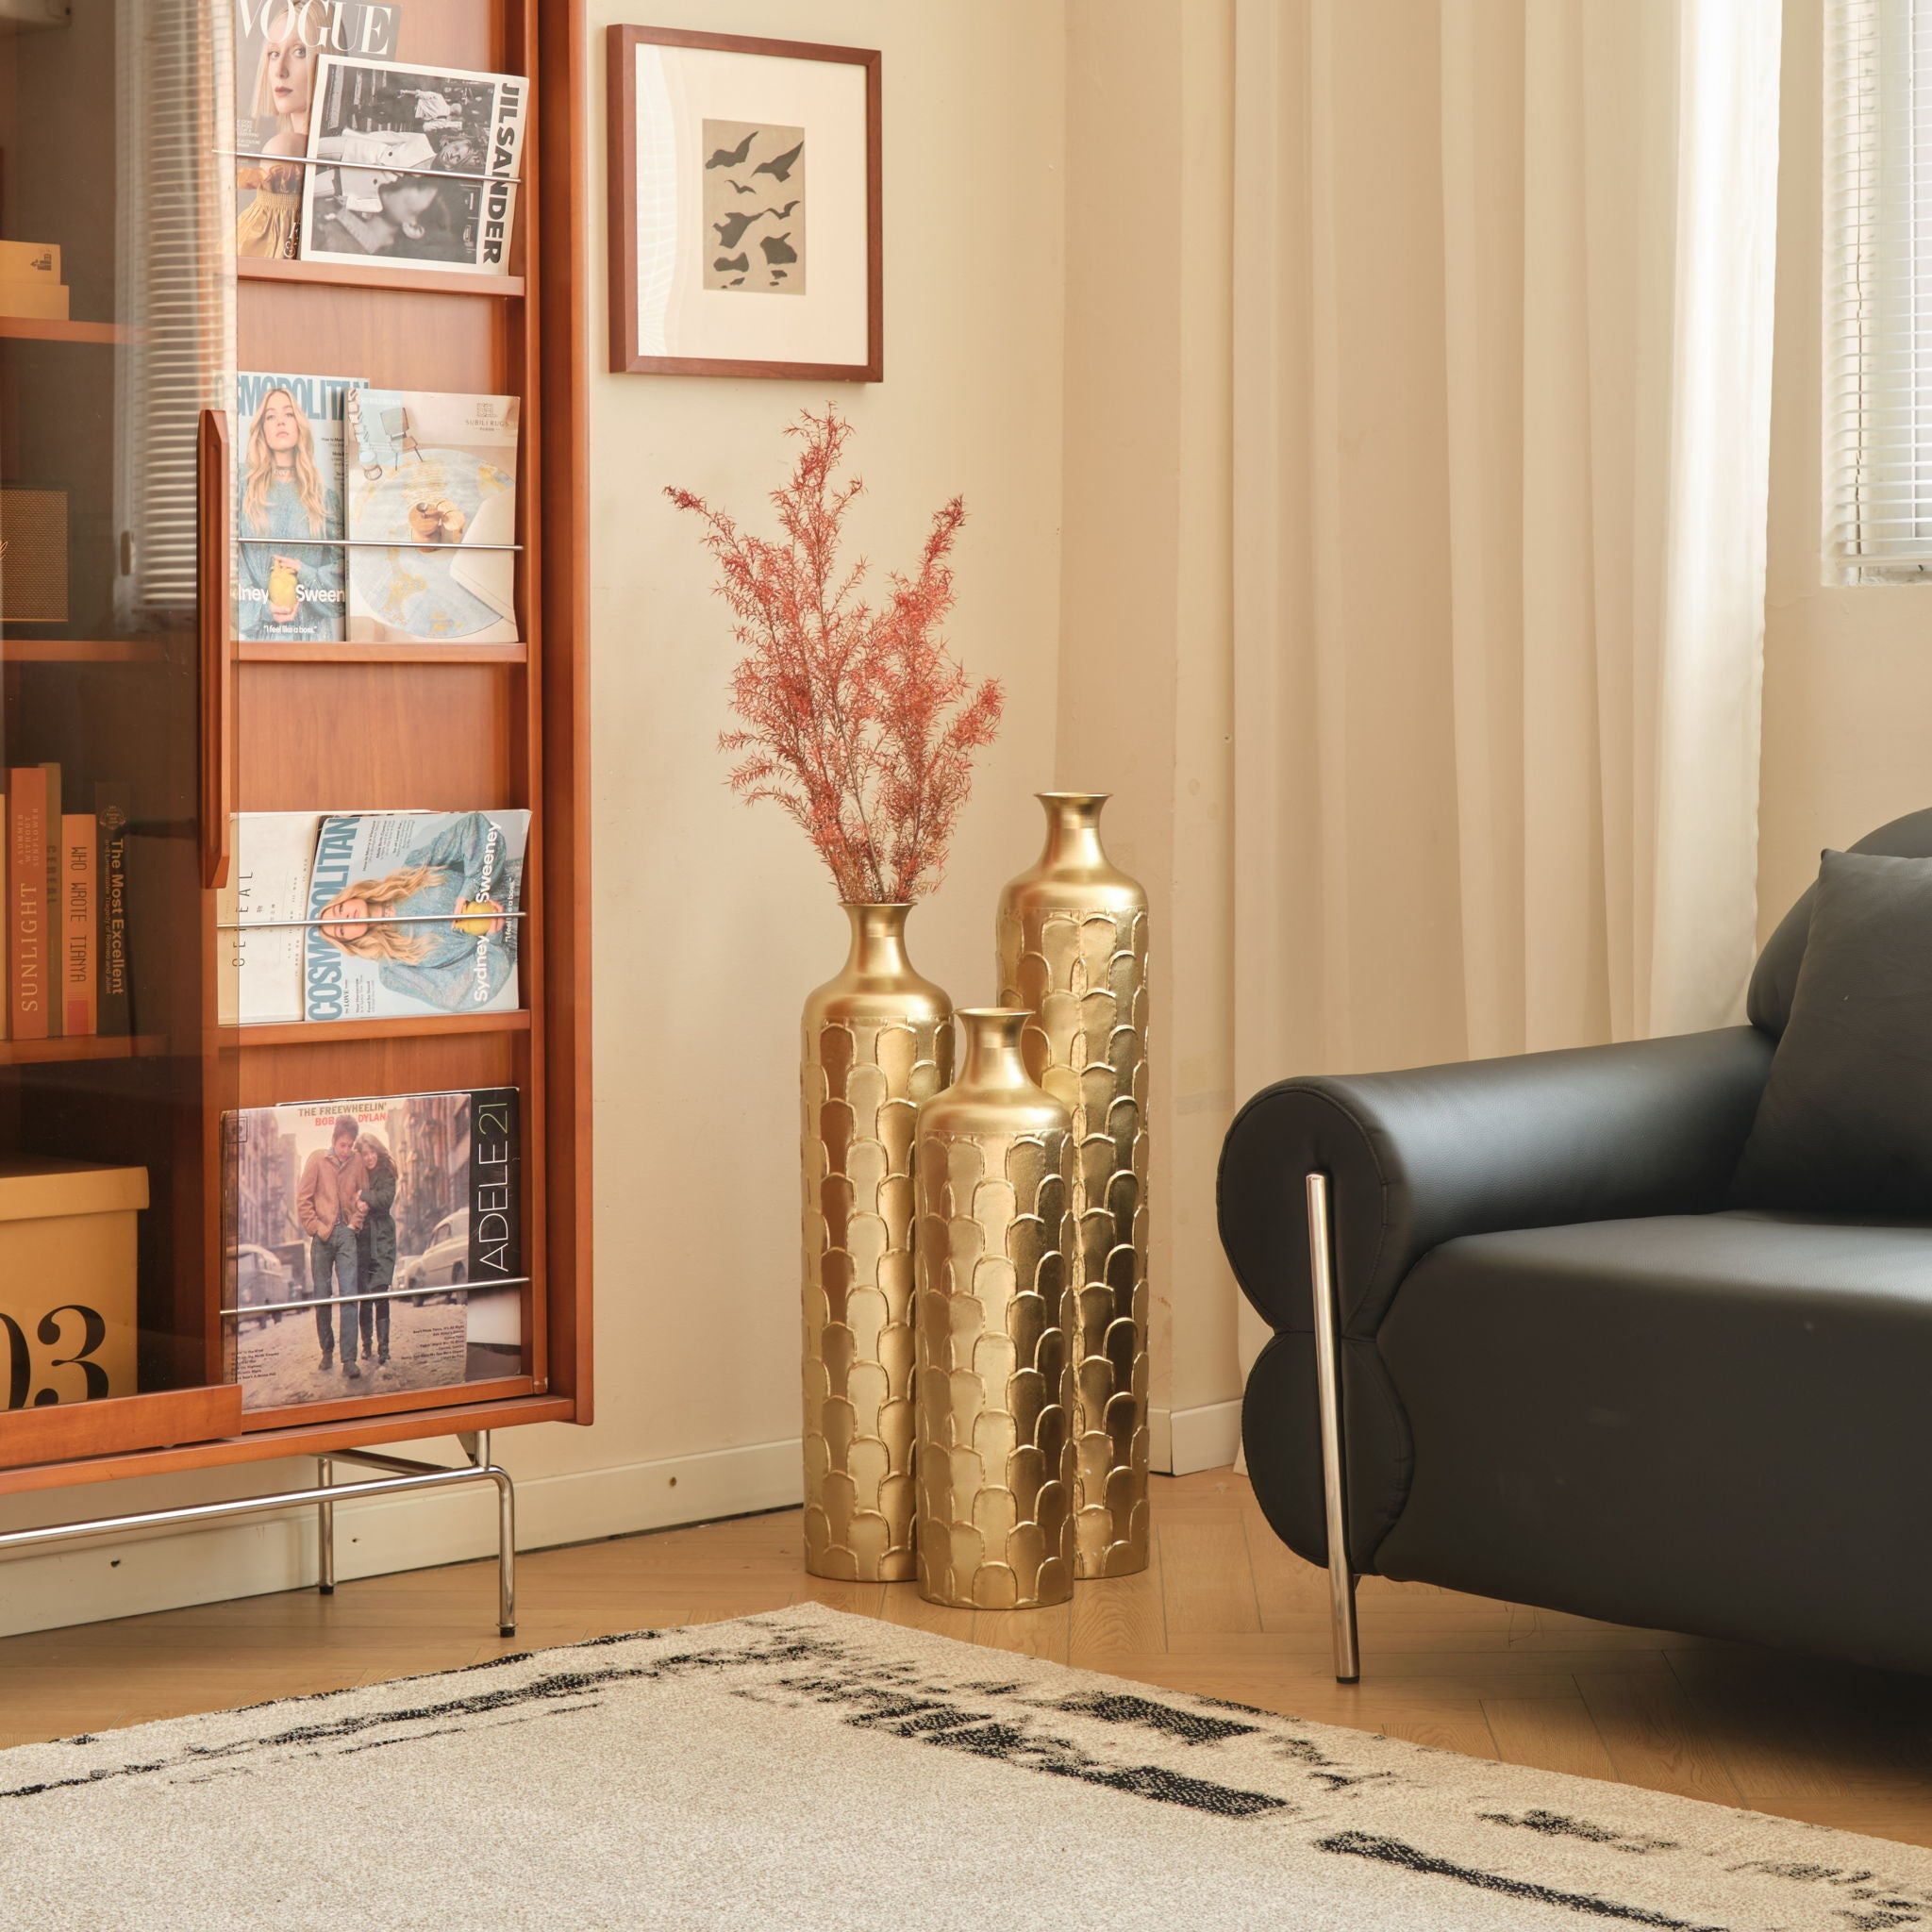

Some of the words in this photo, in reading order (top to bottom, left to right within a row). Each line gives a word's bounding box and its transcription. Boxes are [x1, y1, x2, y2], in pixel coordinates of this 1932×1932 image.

[240, 0, 392, 55] VOGUE
[71, 846, 87, 871] WHO
[111, 838, 124, 869] The
[475, 821, 502, 904] Sweeney
[71, 882, 87, 923] WROTE
[111, 874, 125, 914] Most
[21, 883, 38, 1012] SUNLIGHT
[70, 934, 87, 983] TIANYA
[112, 919, 125, 994] Excellent
[474, 935, 491, 1002] Sydney
[298, 1108, 317, 1117] THE
[319, 1102, 387, 1115] FREEWHEELIN'
[314, 1116, 335, 1126] BOB
[358, 1113, 386, 1123] DYLAN
[479, 1103, 508, 1135] 21
[479, 1141, 508, 1272] ADELE
